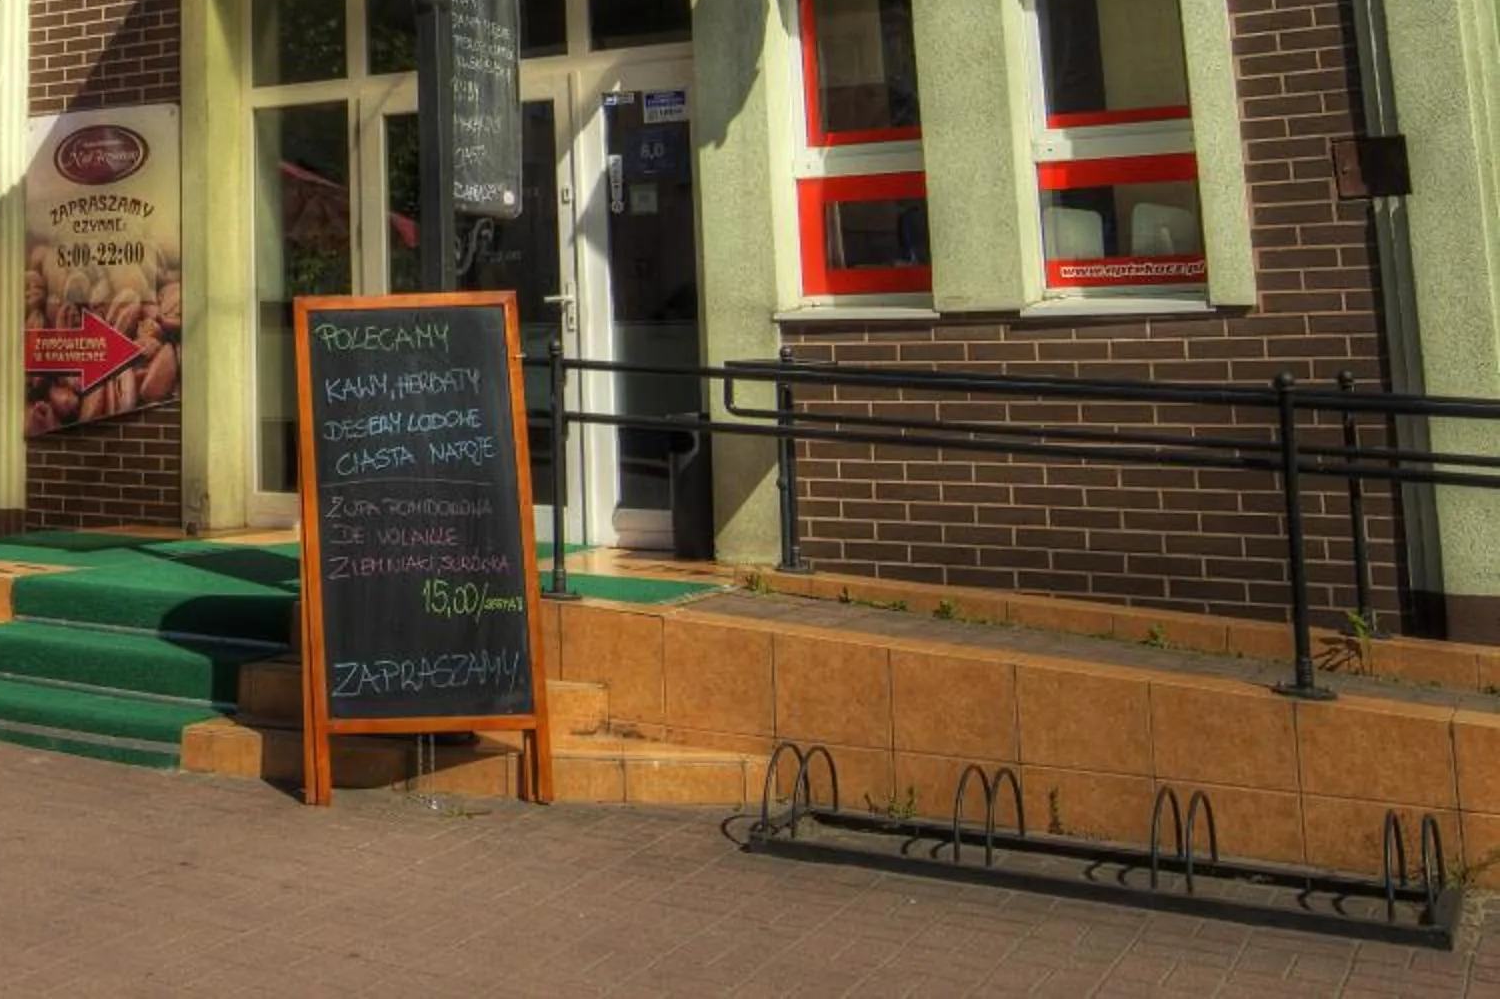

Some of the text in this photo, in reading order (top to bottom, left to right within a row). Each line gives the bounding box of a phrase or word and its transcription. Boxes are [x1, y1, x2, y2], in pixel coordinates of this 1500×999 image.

[50, 194, 155, 226] ZAPRASZAMY
[57, 241, 145, 268] 8:00-22:00
[315, 323, 450, 352] POLECAMY
[336, 446, 415, 475] CIASTA
[332, 649, 519, 697] ZAPRASZAMY
